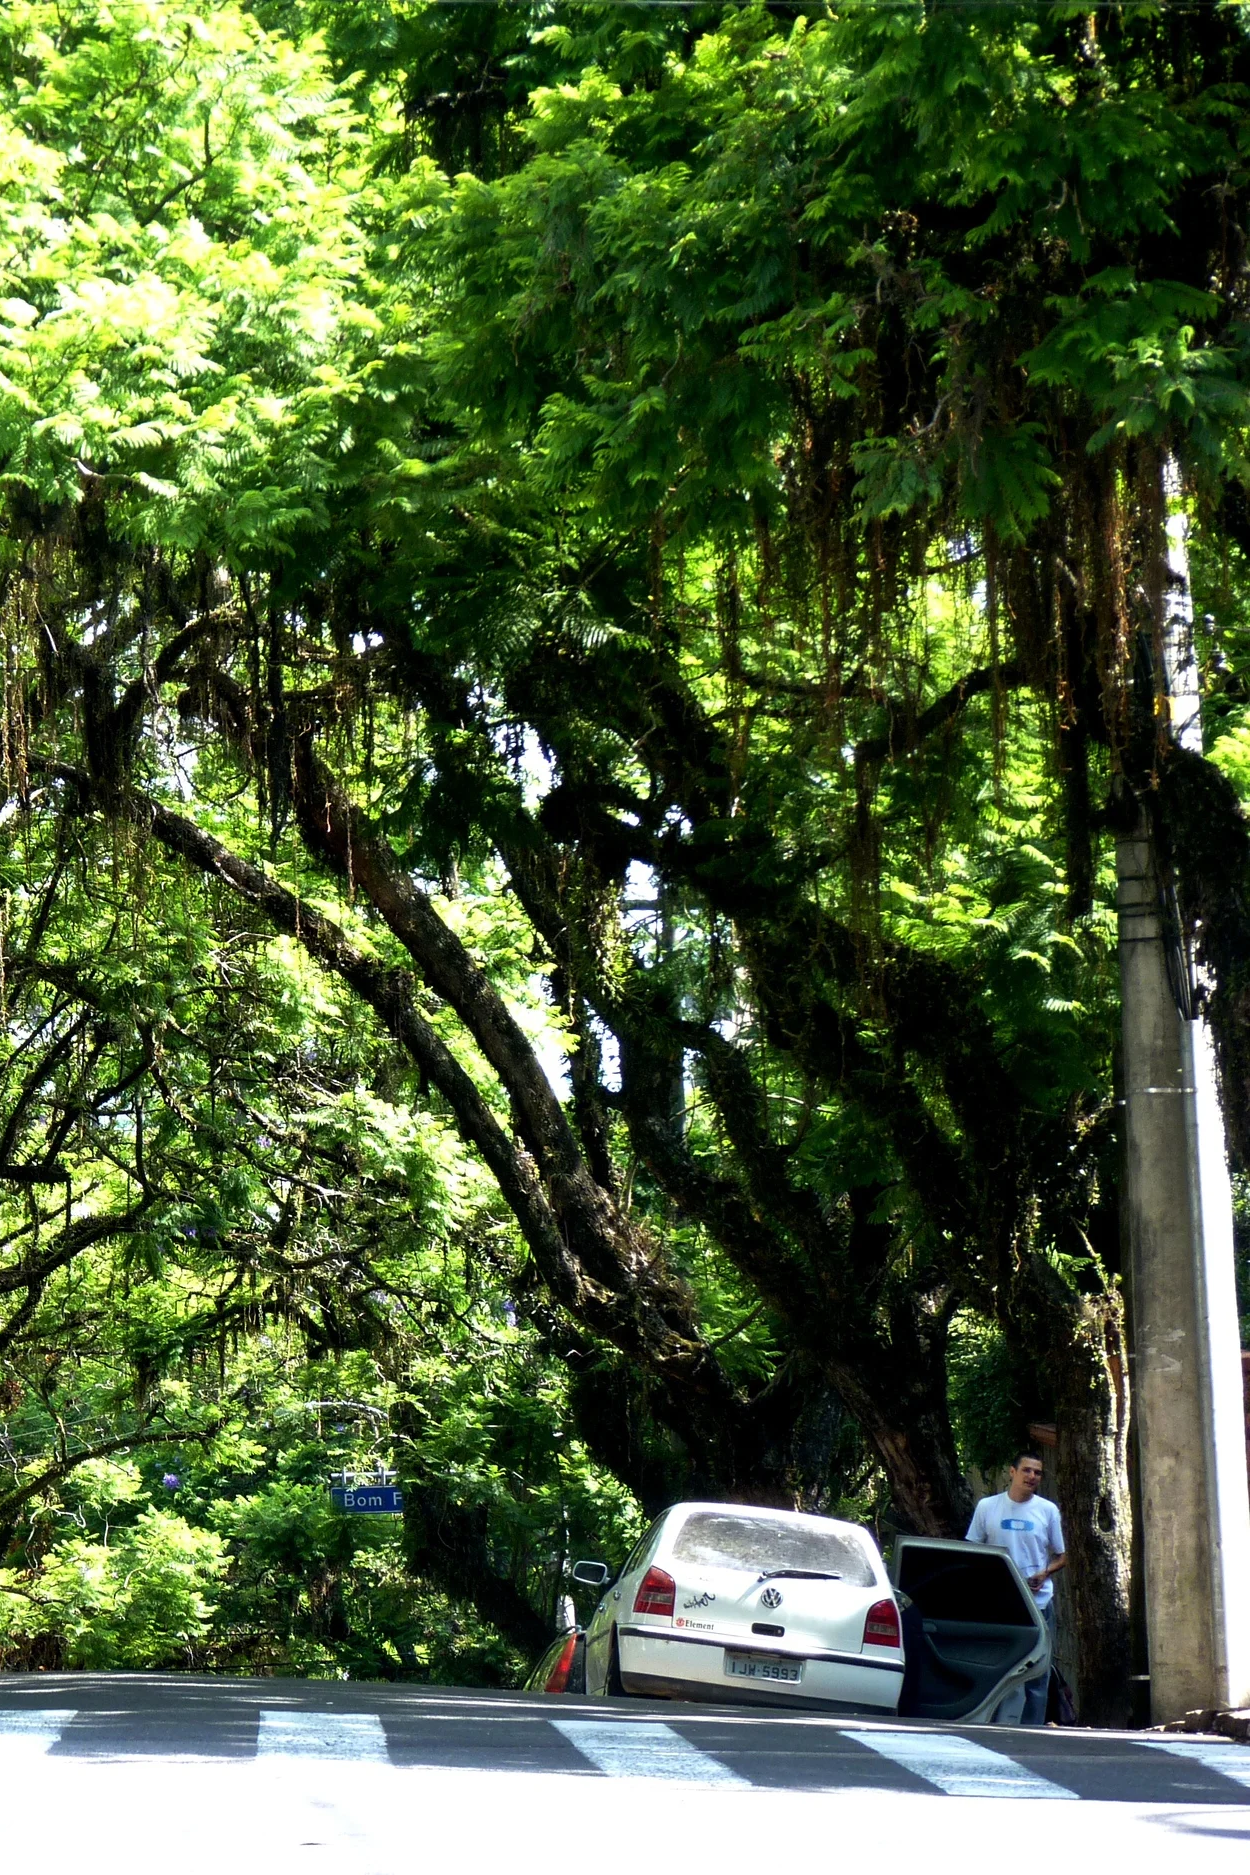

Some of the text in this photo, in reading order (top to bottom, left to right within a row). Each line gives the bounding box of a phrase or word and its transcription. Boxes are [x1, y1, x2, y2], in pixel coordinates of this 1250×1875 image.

[344, 1492, 402, 1507] Bom F
[685, 1619, 715, 1631] Element
